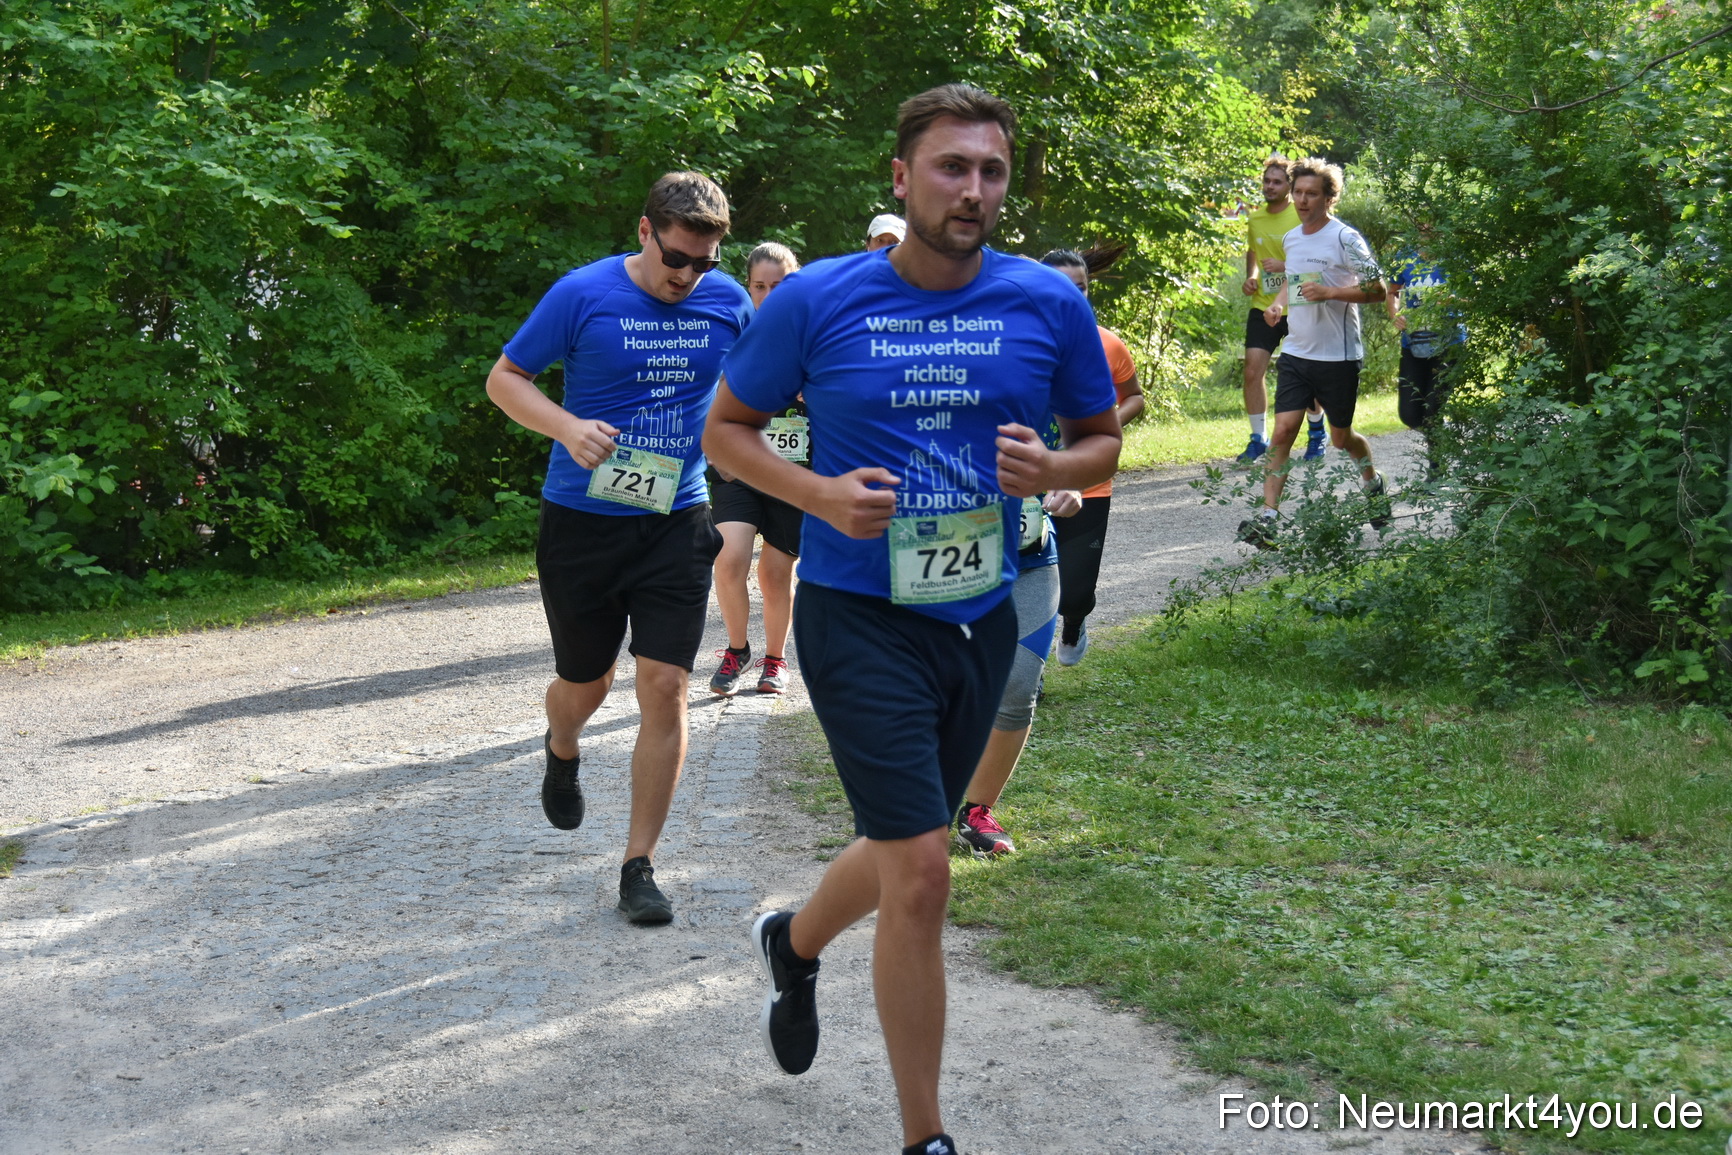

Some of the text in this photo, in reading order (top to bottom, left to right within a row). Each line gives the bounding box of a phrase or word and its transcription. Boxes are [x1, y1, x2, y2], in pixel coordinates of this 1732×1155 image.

[620, 318, 710, 331] Wenn es beim
[866, 315, 1004, 333] Wenn es beim
[624, 334, 710, 350] Hausverkauf
[870, 337, 1001, 357] Hausverkauf
[647, 354, 688, 368] richtig
[637, 371, 695, 383] LAUFEN
[904, 363, 967, 385] richtig
[651, 386, 675, 398] soll!
[890, 389, 980, 408] LAUFEN
[916, 411, 952, 431] soll!
[611, 467, 656, 496] 721
[635, 493, 657, 504] Markus
[895, 492, 999, 510] ELDBUSCH
[917, 541, 982, 579] 724
[910, 578, 958, 590] Feldbusch
